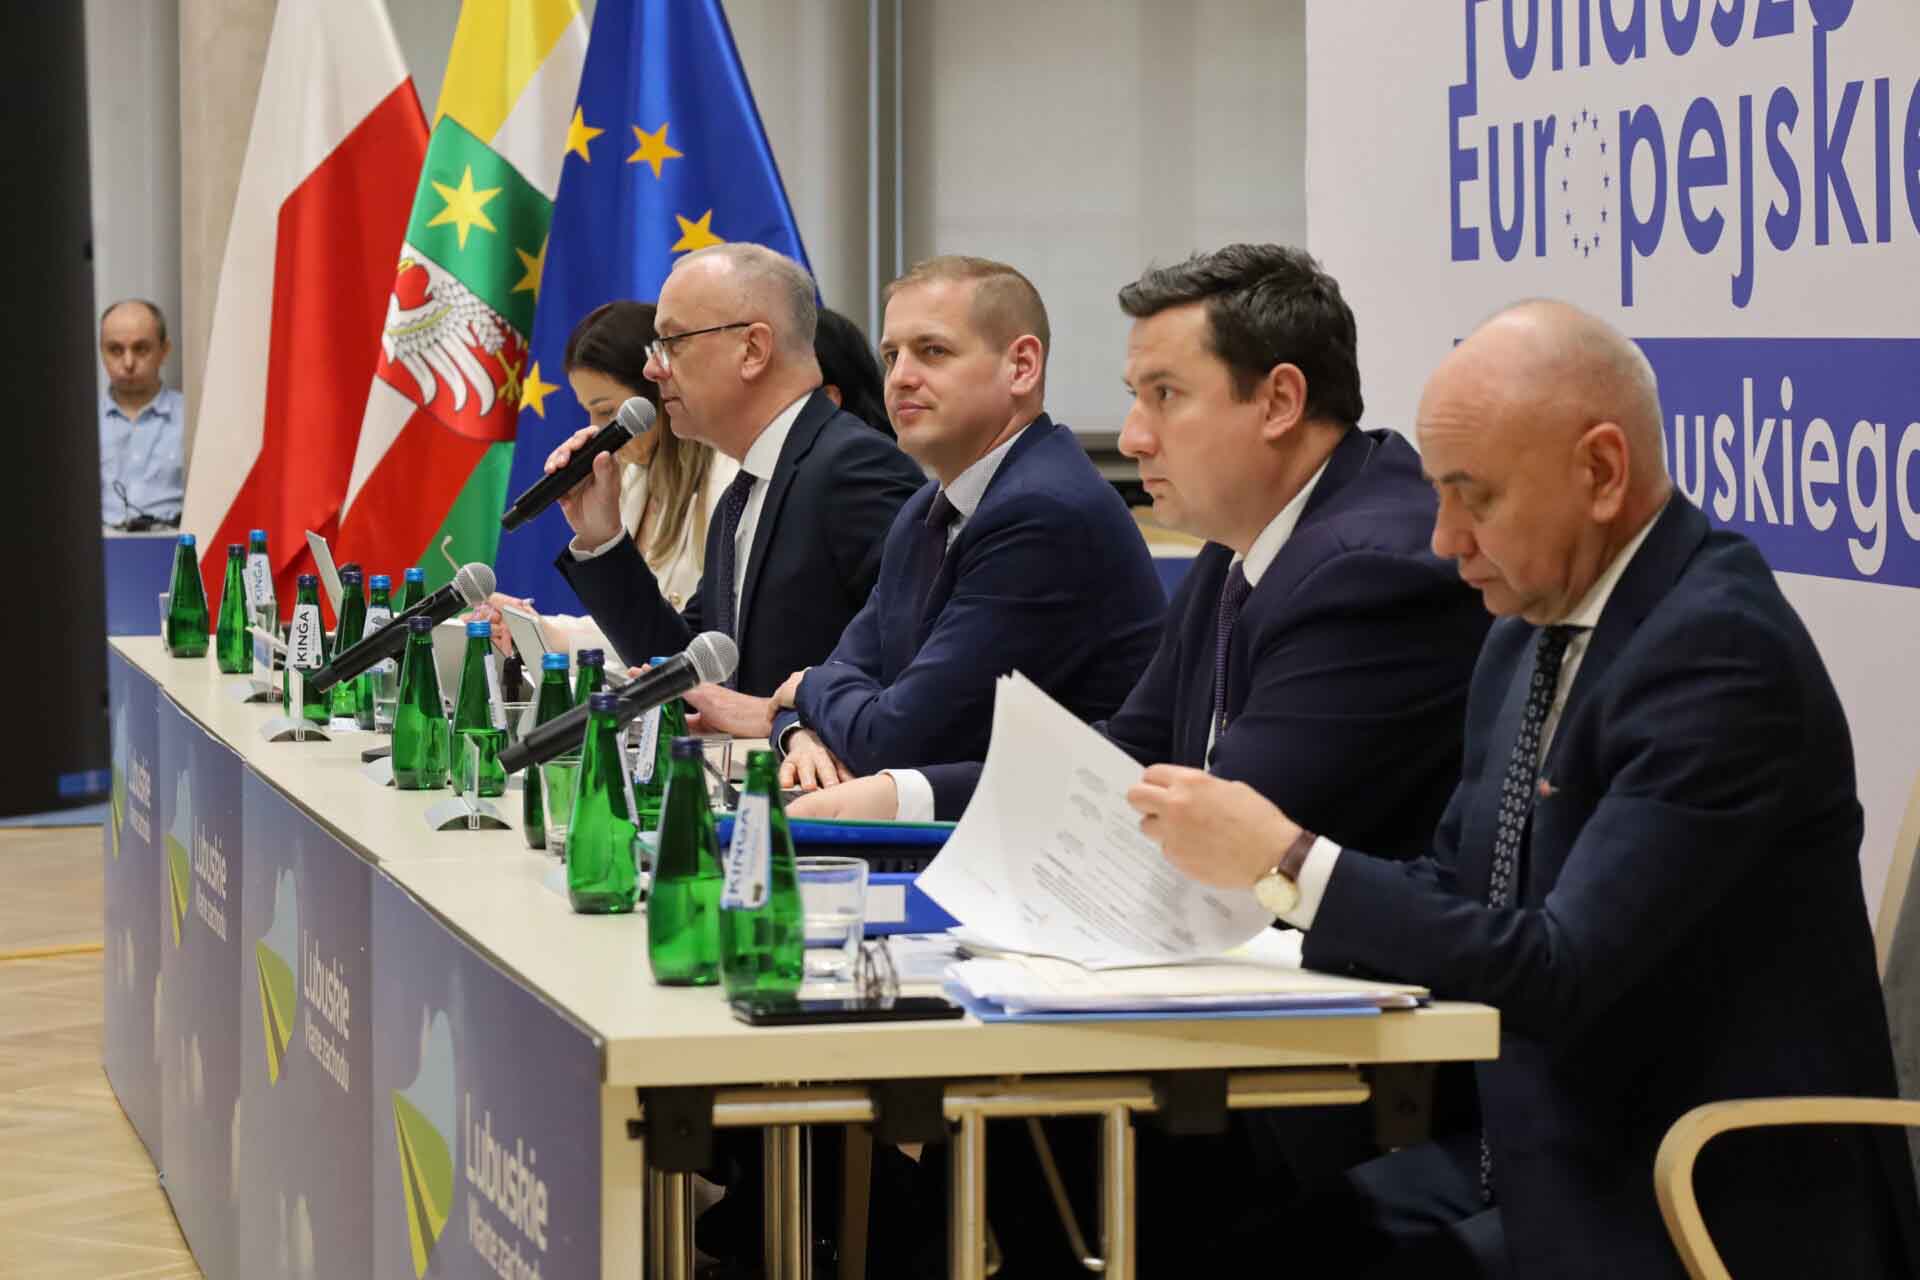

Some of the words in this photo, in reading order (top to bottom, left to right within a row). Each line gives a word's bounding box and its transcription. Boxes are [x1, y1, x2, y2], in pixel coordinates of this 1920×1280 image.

[1662, 376, 1920, 576] uskiego
[296, 611, 310, 662] KINGA
[303, 929, 349, 1040] Lubuskie
[464, 1091, 547, 1251] Lubuskie
